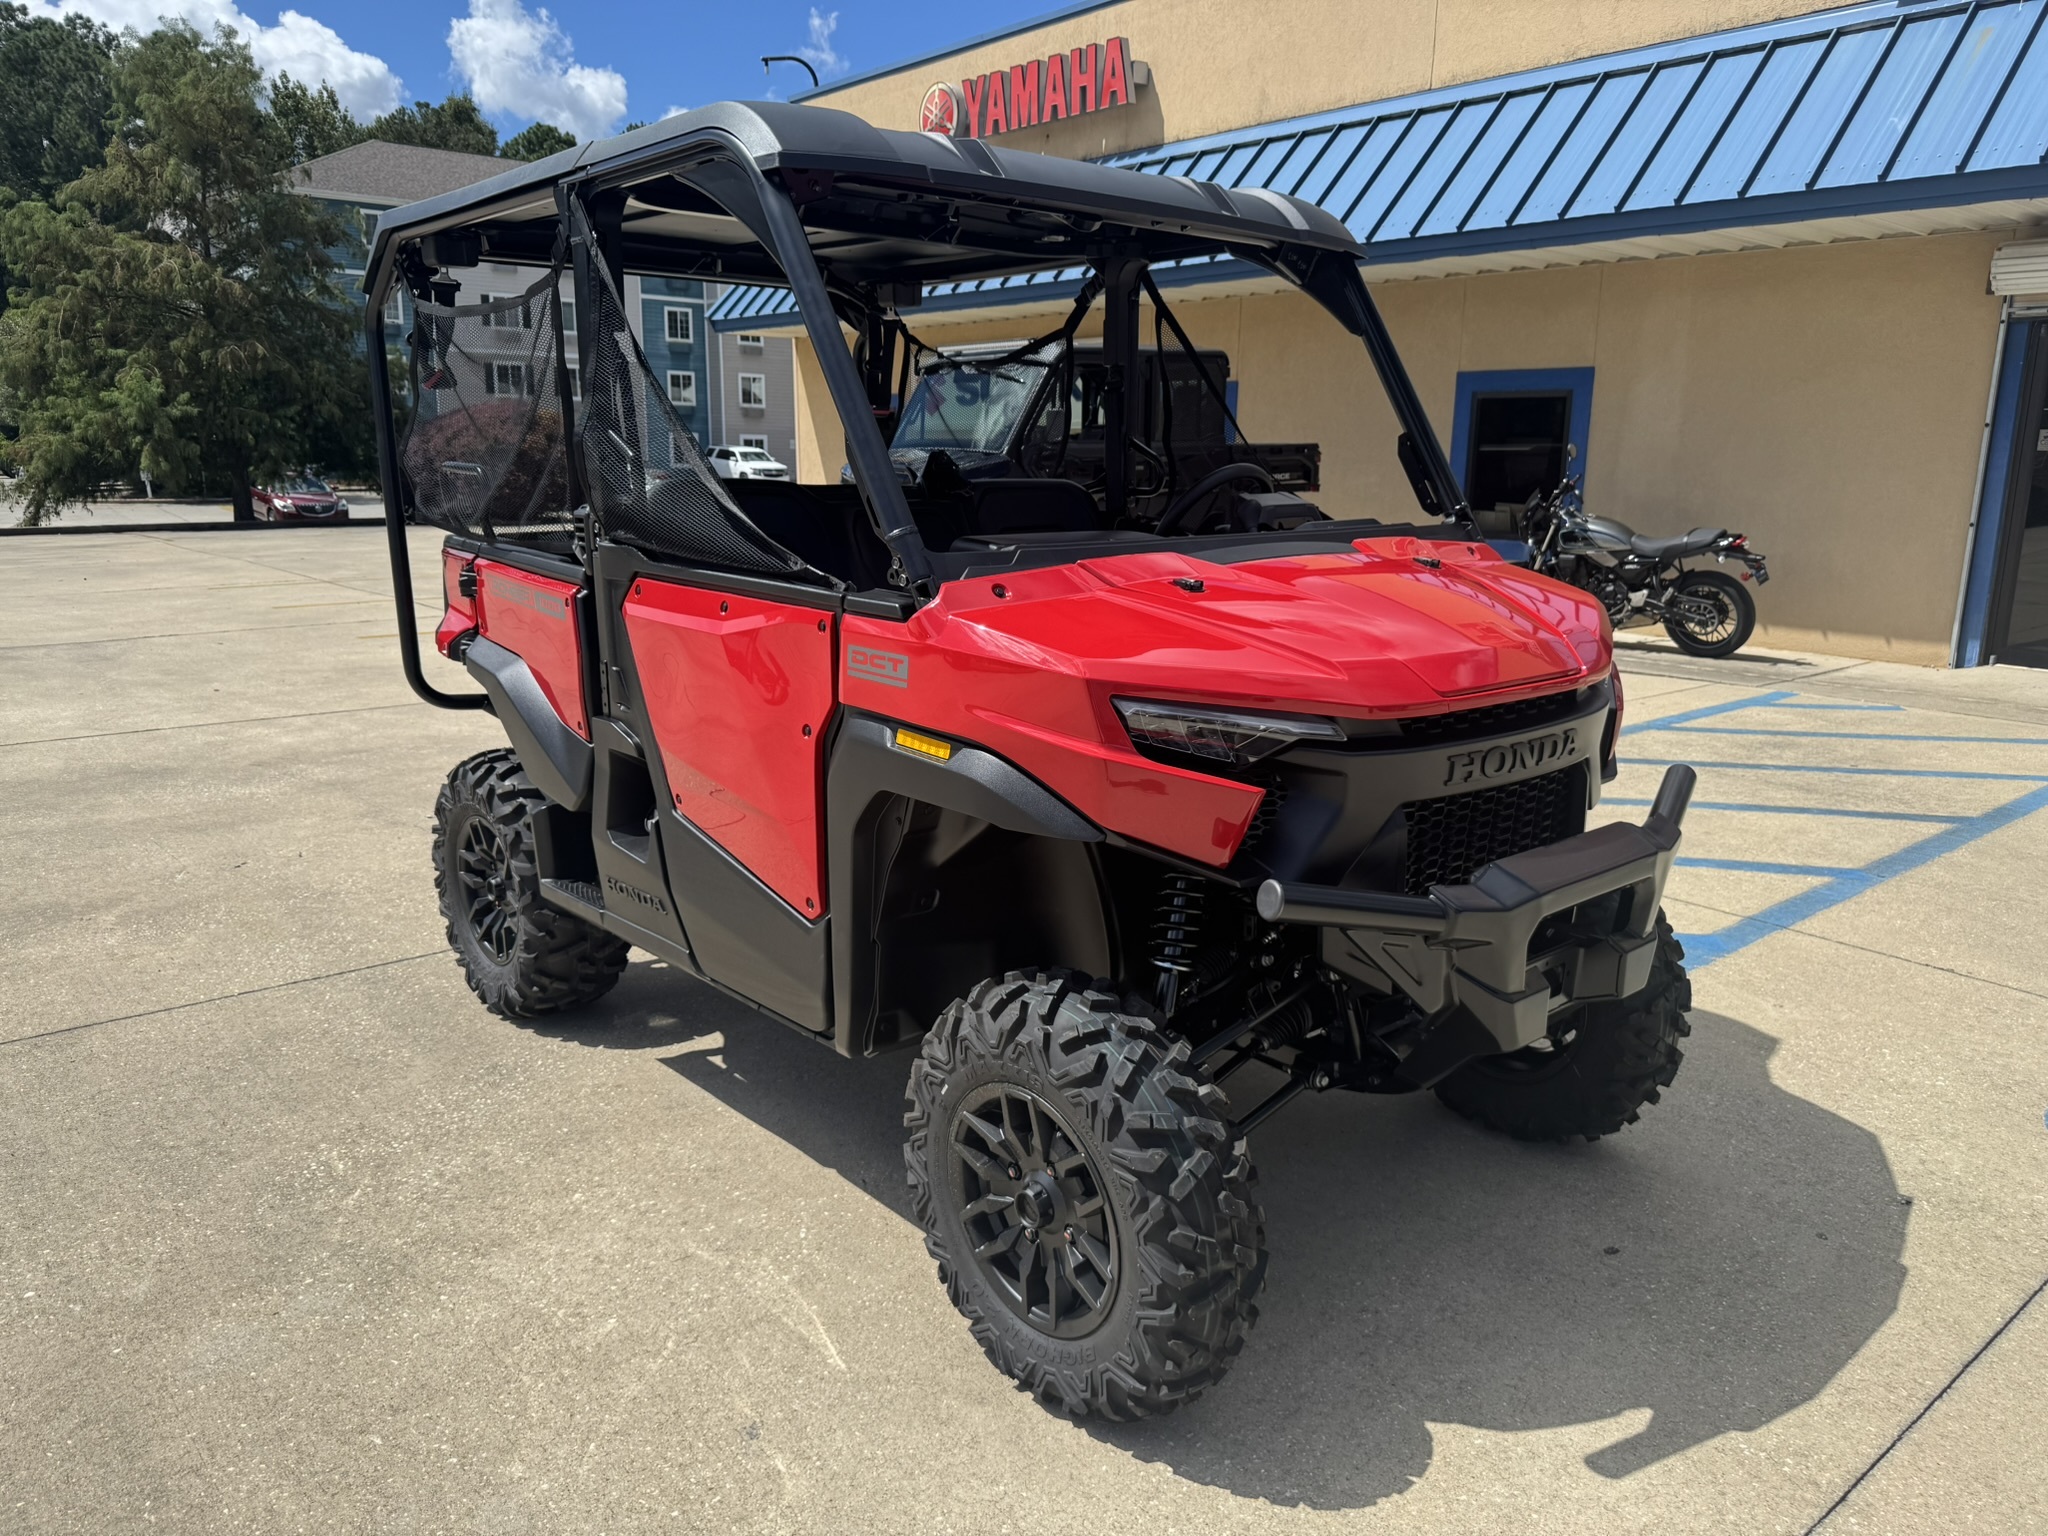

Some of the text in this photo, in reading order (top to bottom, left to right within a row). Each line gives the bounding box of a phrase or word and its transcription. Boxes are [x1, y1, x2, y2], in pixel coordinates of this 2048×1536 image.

[962, 36, 1130, 138] YAMAHA
[851, 650, 904, 673] DCT
[1443, 727, 1578, 786] HONDA
[606, 874, 668, 916] HONDA
